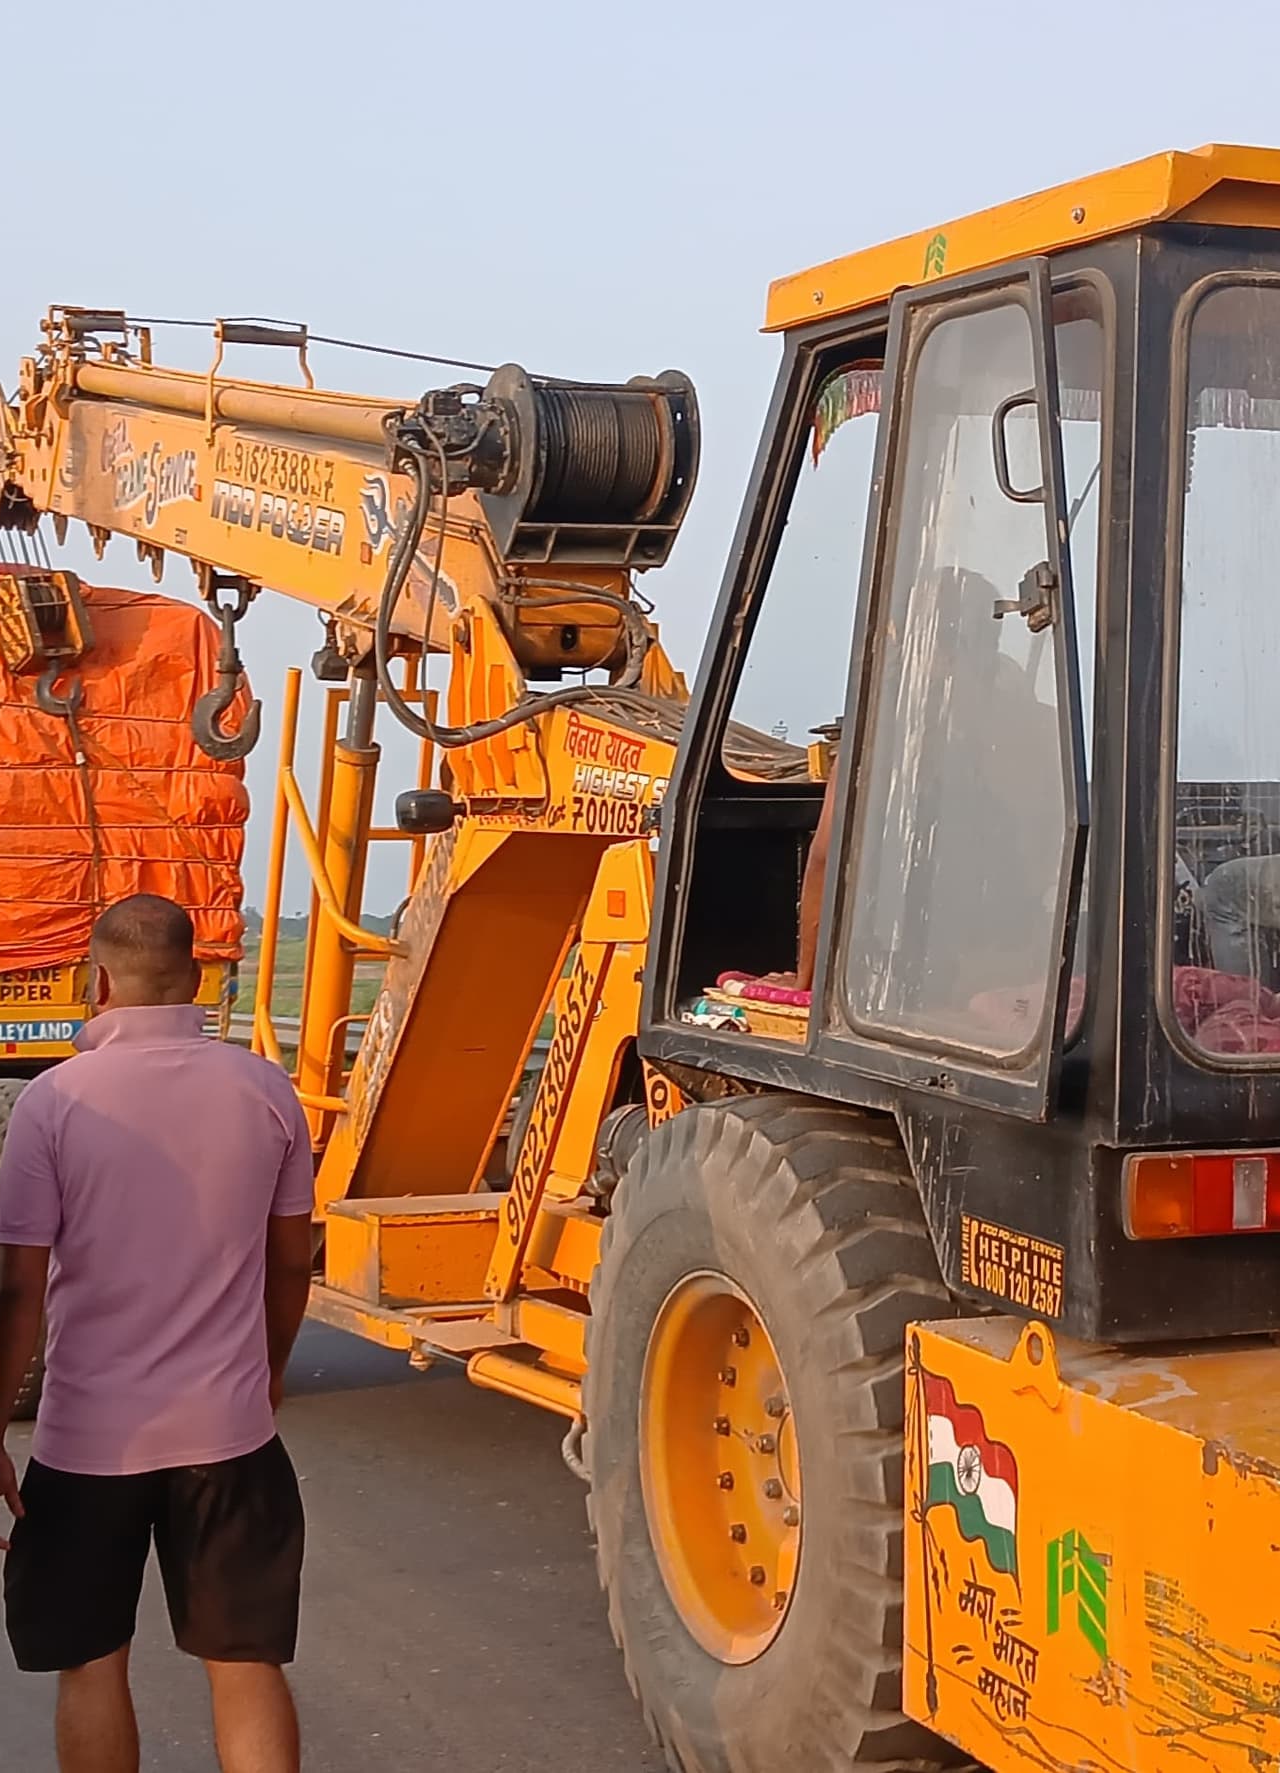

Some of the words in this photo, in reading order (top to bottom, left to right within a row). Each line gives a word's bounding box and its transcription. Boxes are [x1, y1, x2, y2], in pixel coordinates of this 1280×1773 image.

[257, 491, 347, 556] POWER
[564, 711, 604, 762] विनय
[605, 731, 646, 772] यादव
[572, 762, 651, 804] HIGHEST
[979, 1235, 1062, 1286] HELPLINE
[979, 1259, 1006, 1297] 1800
[1008, 1269, 1030, 1306] 120
[1031, 1279, 1062, 1318] 2587
[992, 1619, 1039, 1688] भारत
[977, 1666, 1032, 1722] महान
